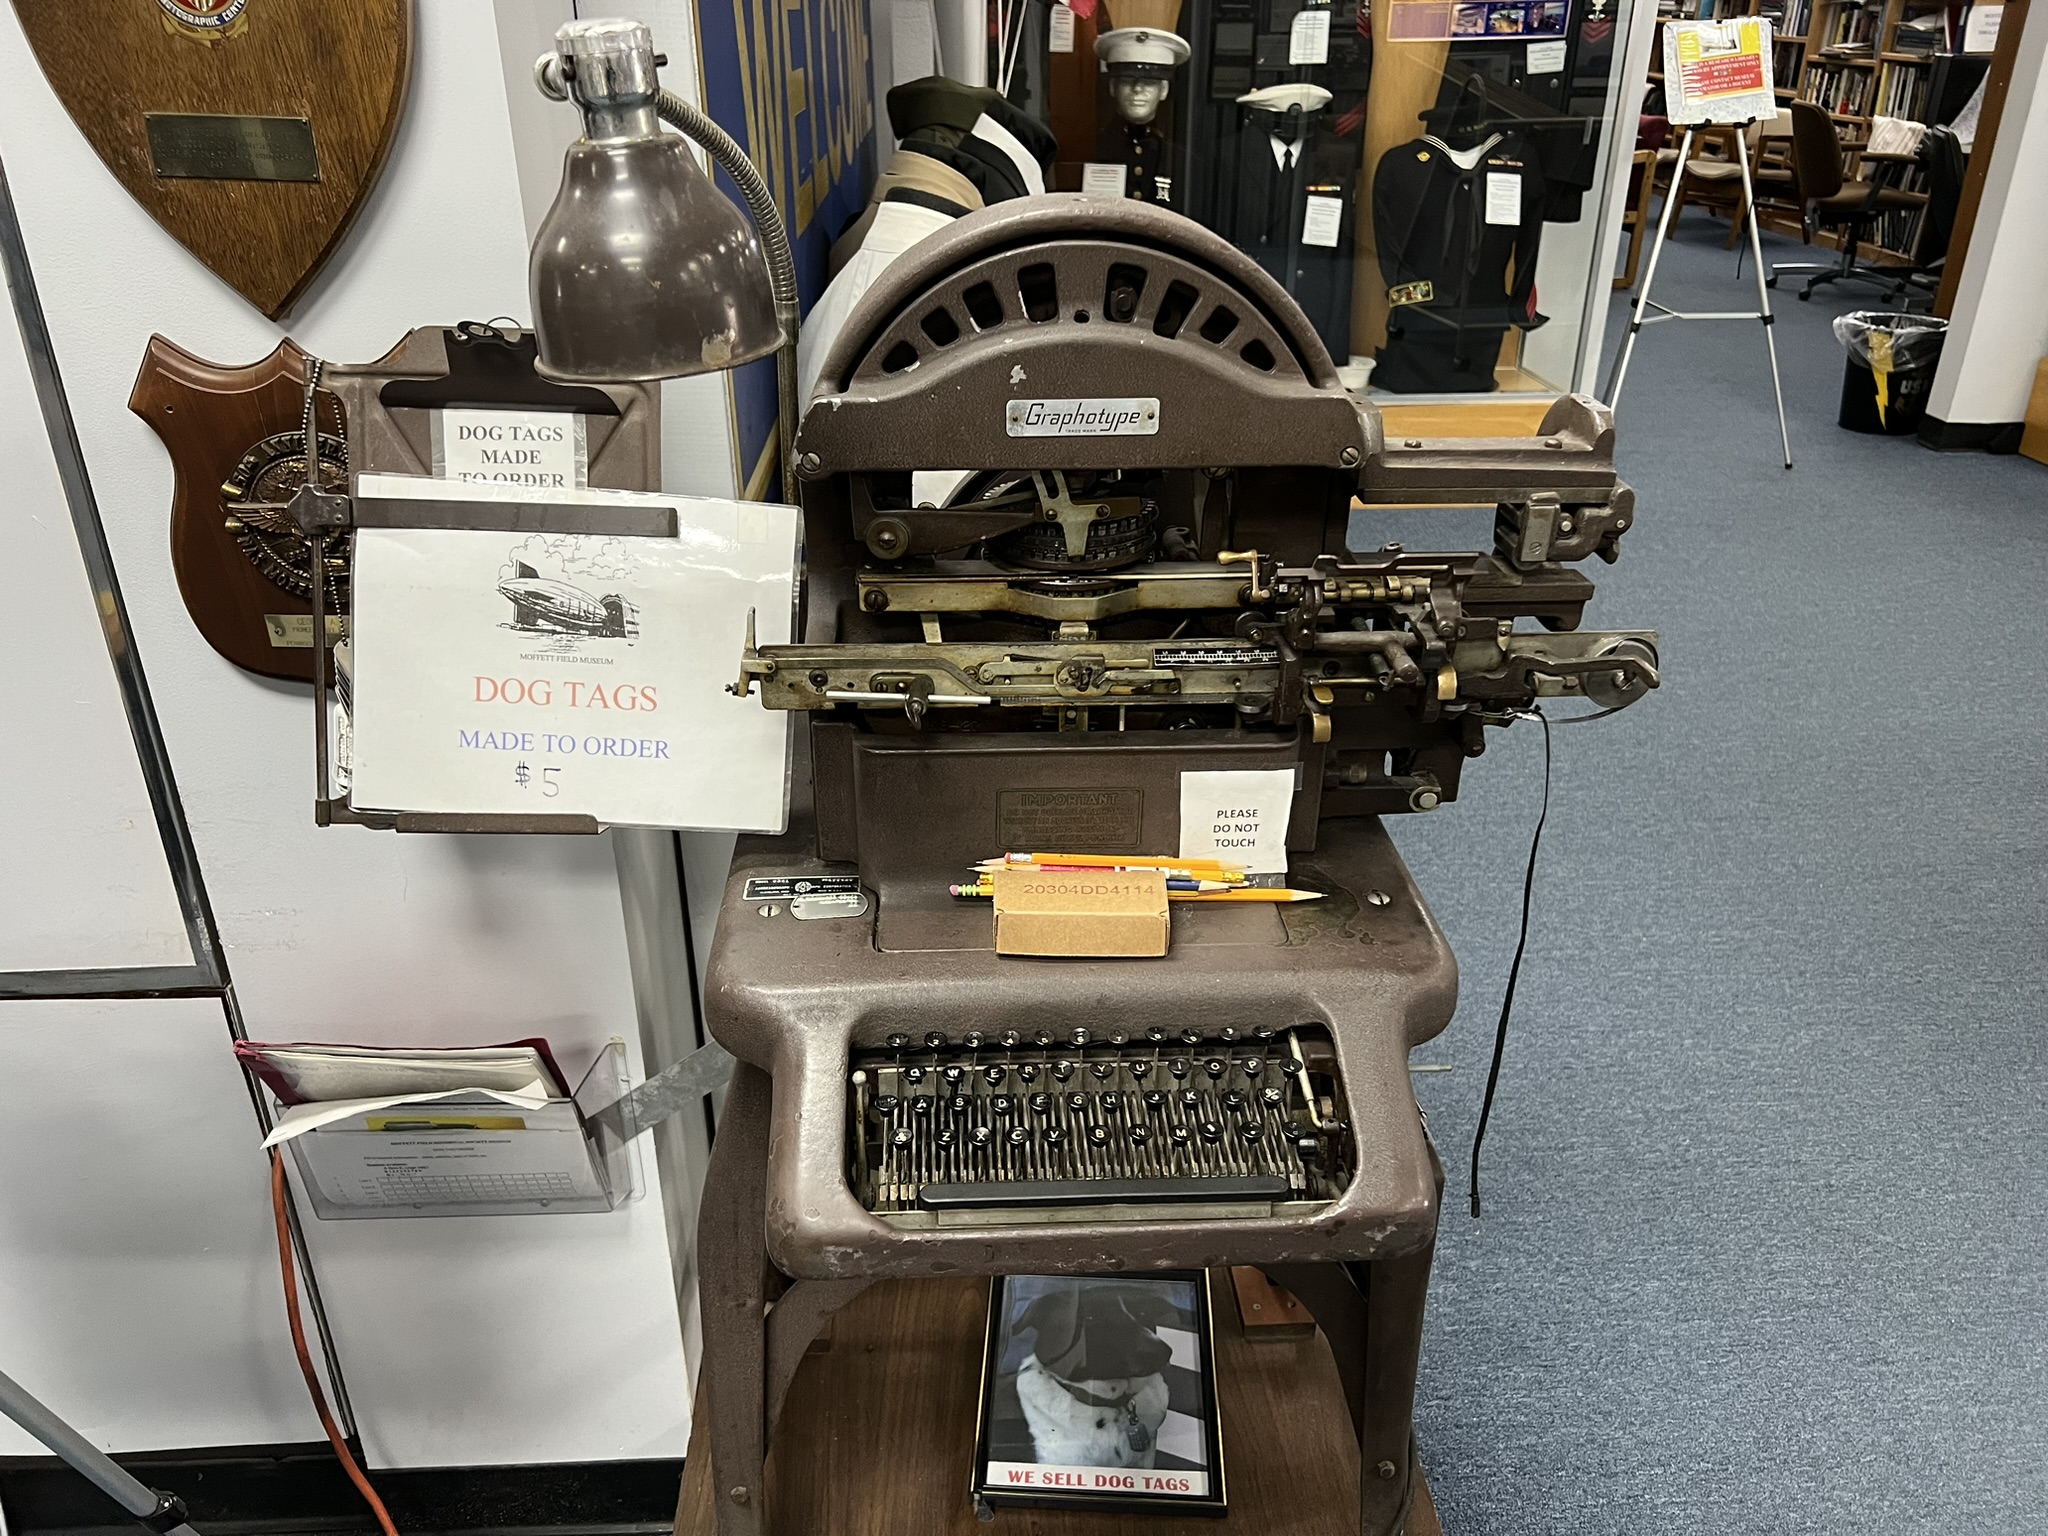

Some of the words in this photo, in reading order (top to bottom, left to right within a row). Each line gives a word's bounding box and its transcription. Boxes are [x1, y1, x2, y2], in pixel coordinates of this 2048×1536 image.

[1026, 402, 1140, 433] Graphotype
[458, 425, 503, 441] DOG
[509, 426, 563, 442] TAGS
[481, 449, 542, 464] MADE
[493, 472, 565, 488] ORDER
[520, 653, 555, 662] MOFFETT
[556, 655, 578, 663] FIELD
[579, 657, 614, 665] MUSEUM
[473, 676, 553, 706] DOG
[563, 681, 658, 712] TAGS
[458, 729, 535, 752] MADE
[542, 734, 576, 754] TO
[583, 736, 671, 759] ORDER
[1020, 793, 1119, 807] IMPORTANT
[1216, 809, 1259, 819] PLEASE
[1213, 824, 1231, 833] DO
[1234, 823, 1260, 833] NOT
[1214, 838, 1256, 848] TOUCH
[1023, 884, 1156, 895] 20304DD4114
[1007, 1470, 1035, 1484] WE
[1042, 1471, 1087, 1487] SELL
[1094, 1474, 1135, 1489] DOG
[1141, 1476, 1190, 1492] TAGS
